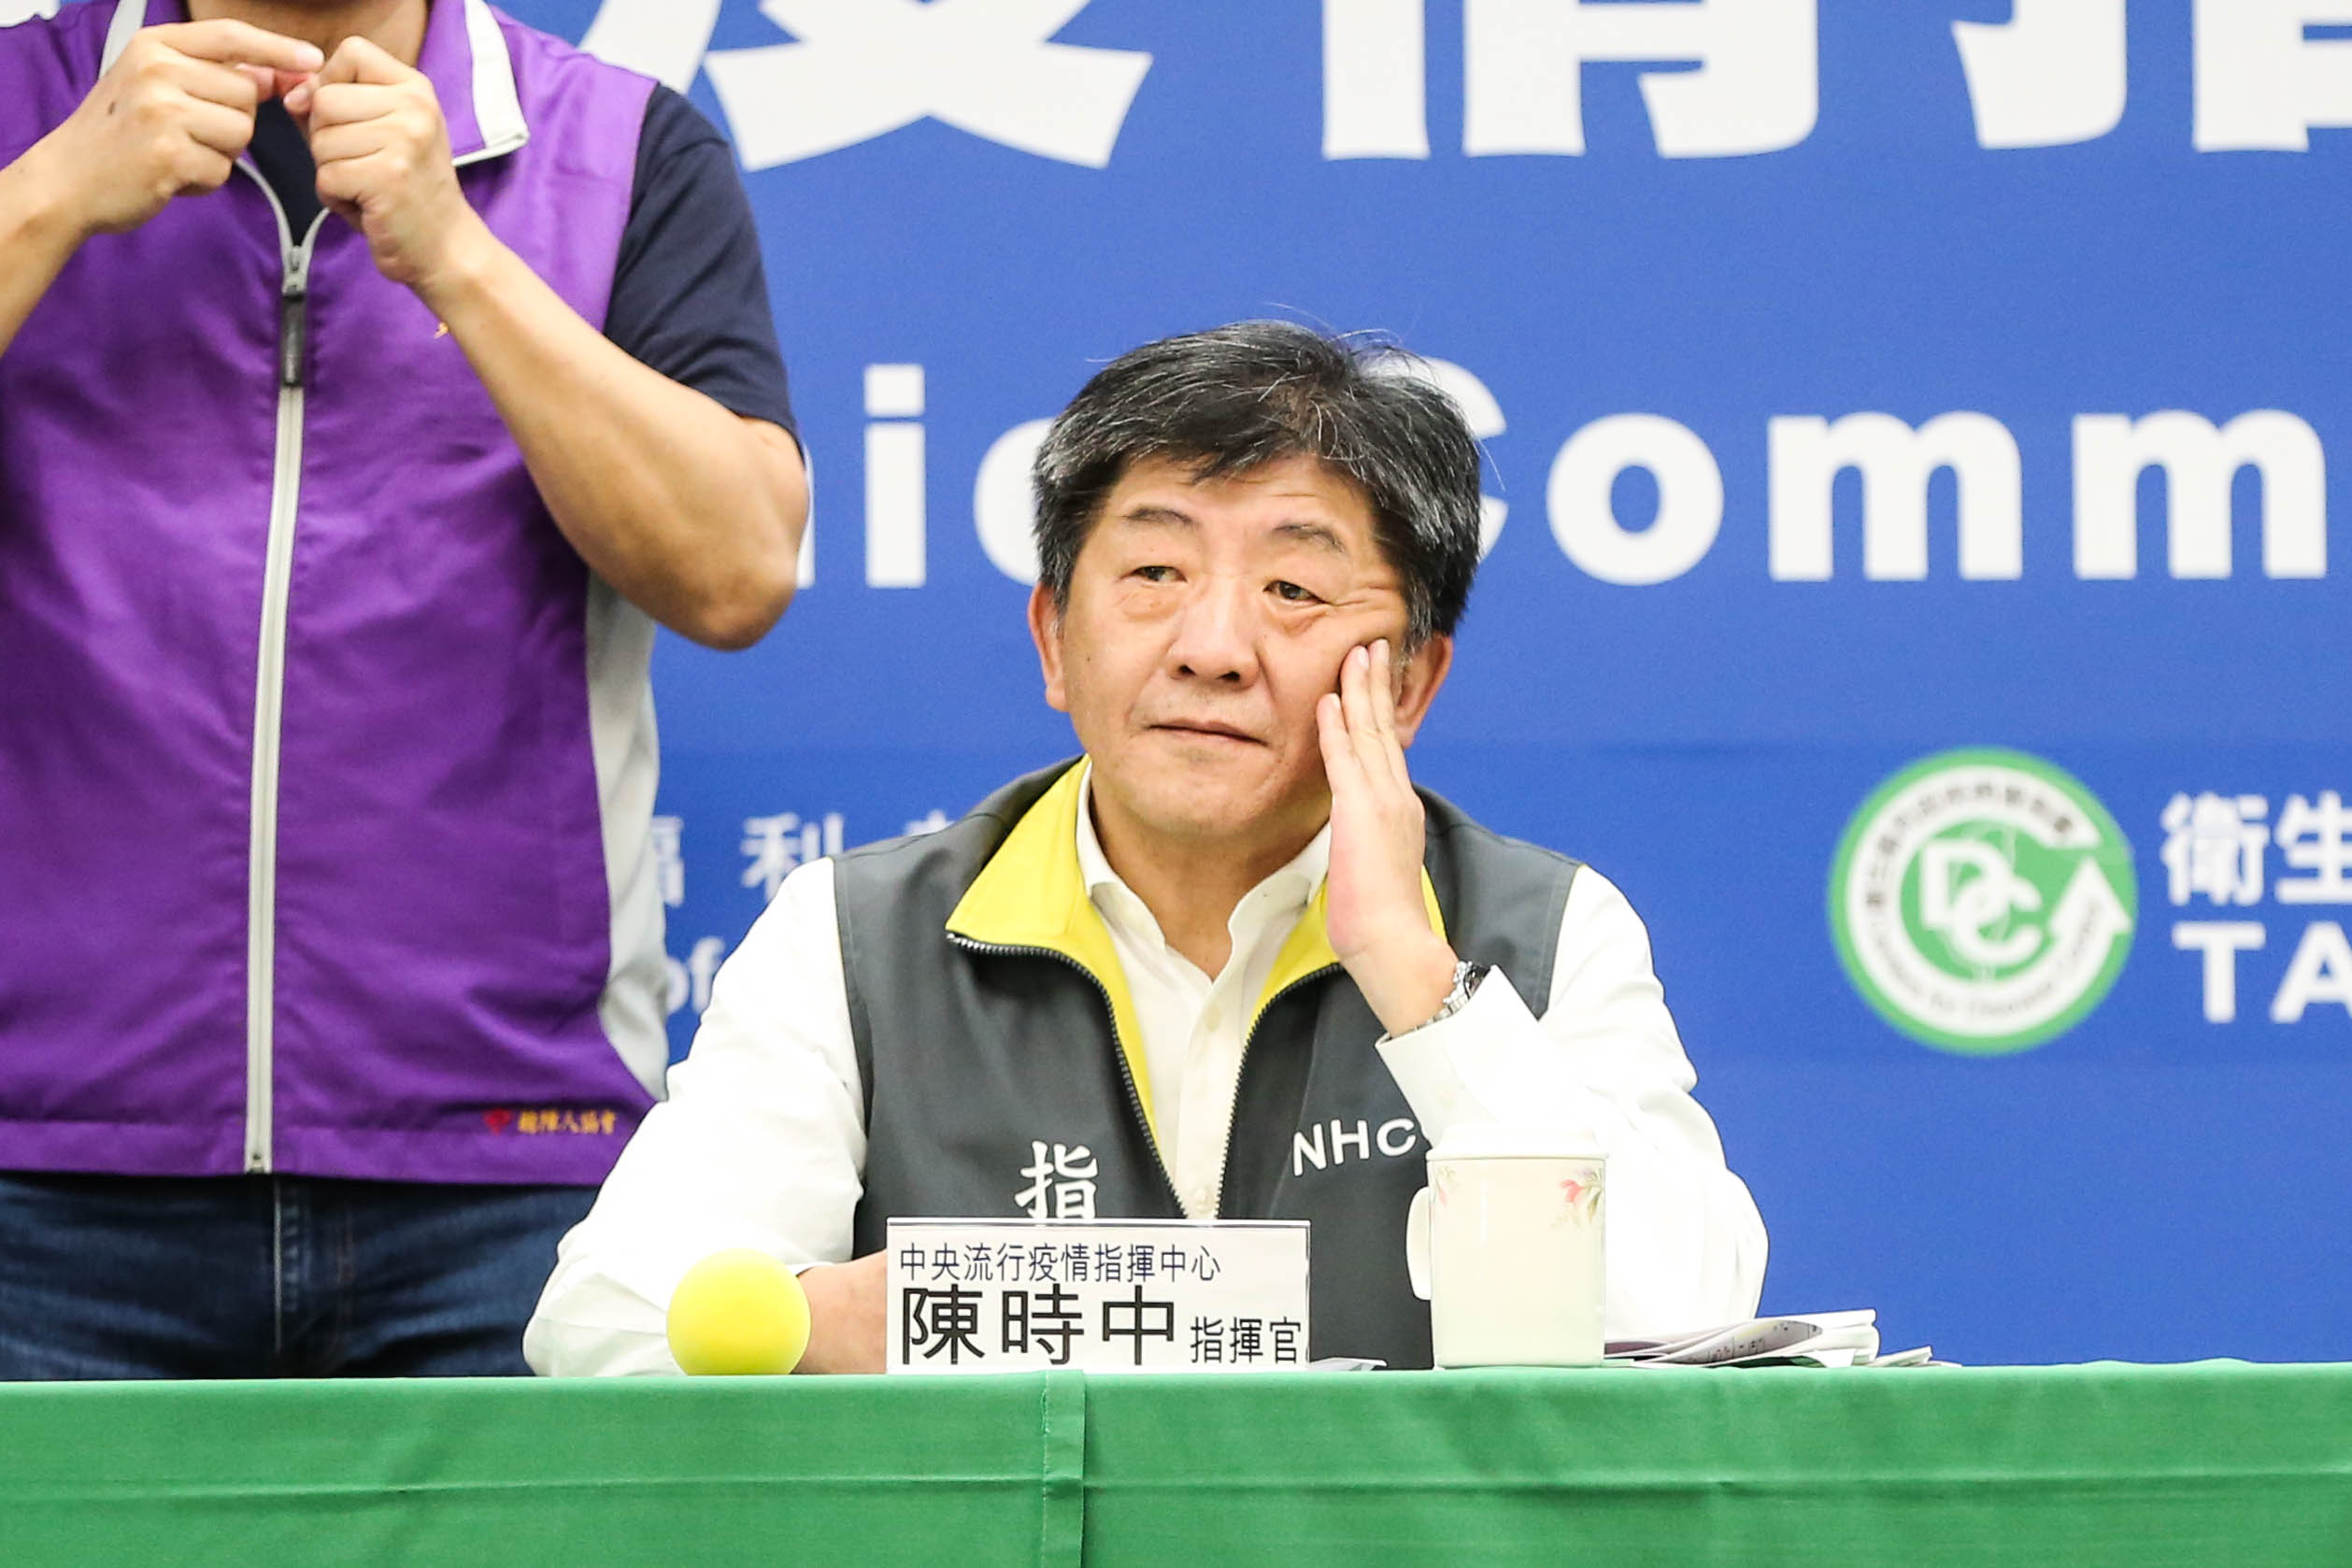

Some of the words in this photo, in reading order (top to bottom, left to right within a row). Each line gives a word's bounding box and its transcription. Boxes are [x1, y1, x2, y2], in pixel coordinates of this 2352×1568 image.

[1364, 356, 2327, 586] omm
[2172, 920, 2352, 1023] TA
[1014, 1140, 1098, 1219] 指
[1293, 1119, 1416, 1176] NHC
[899, 1242, 1221, 1283] 中央流行疫情指揮中心
[902, 1283, 1175, 1366] 陳時中
[1190, 1316, 1303, 1364] 指揮官
